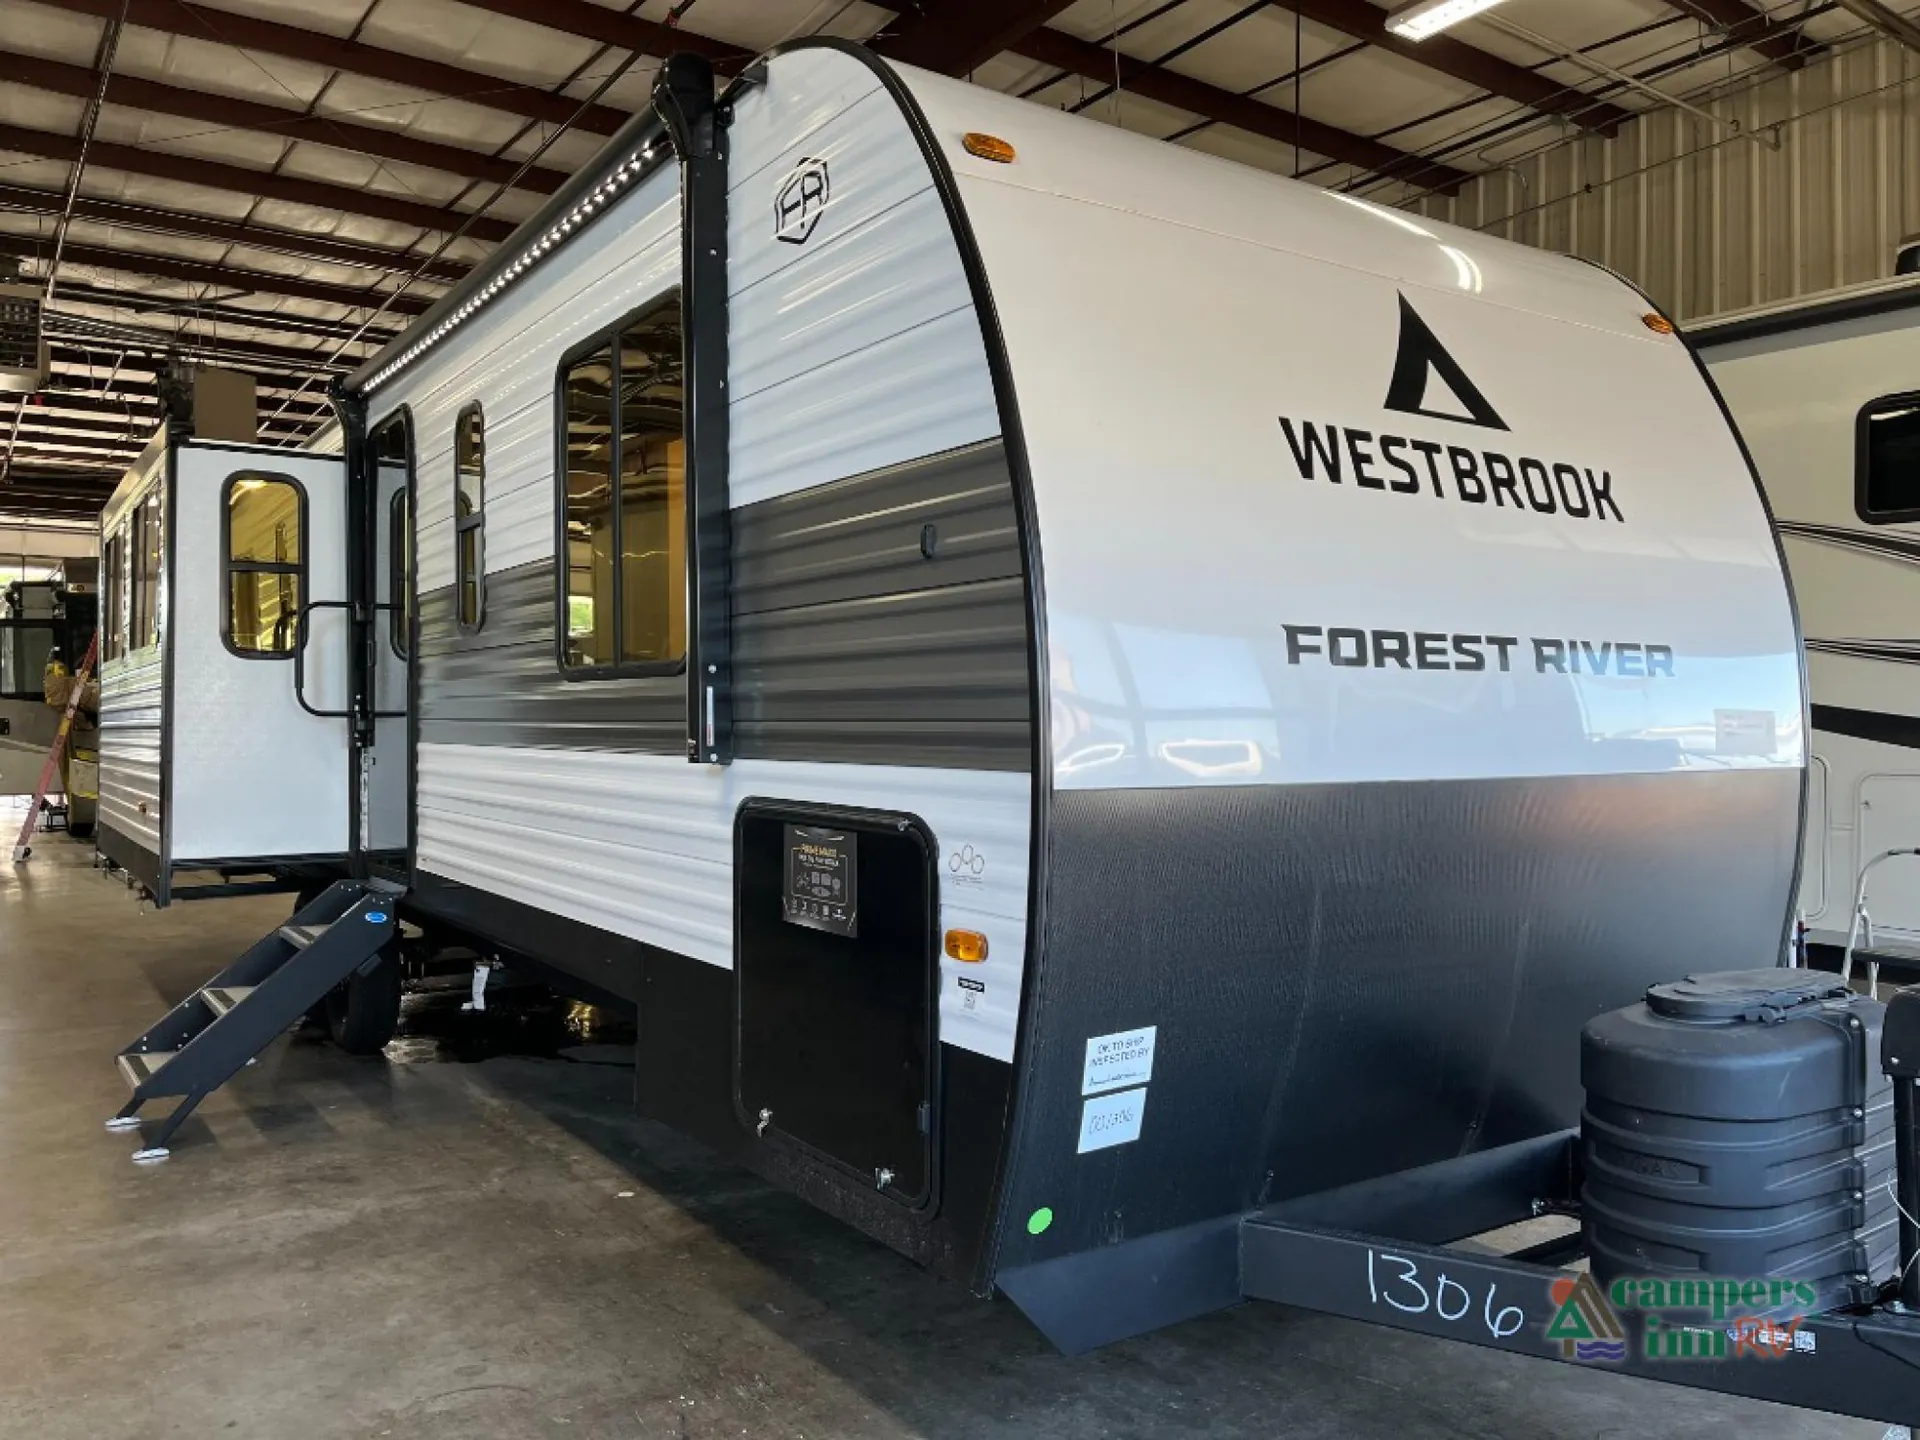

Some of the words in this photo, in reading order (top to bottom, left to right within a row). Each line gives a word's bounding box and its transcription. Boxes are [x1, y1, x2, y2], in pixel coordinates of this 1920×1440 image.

[1278, 416, 1625, 523] WESTBROOK
[1280, 624, 1518, 672] FOREST
[1530, 637, 1676, 677] RIVER
[1367, 1248, 1525, 1338] 1306
